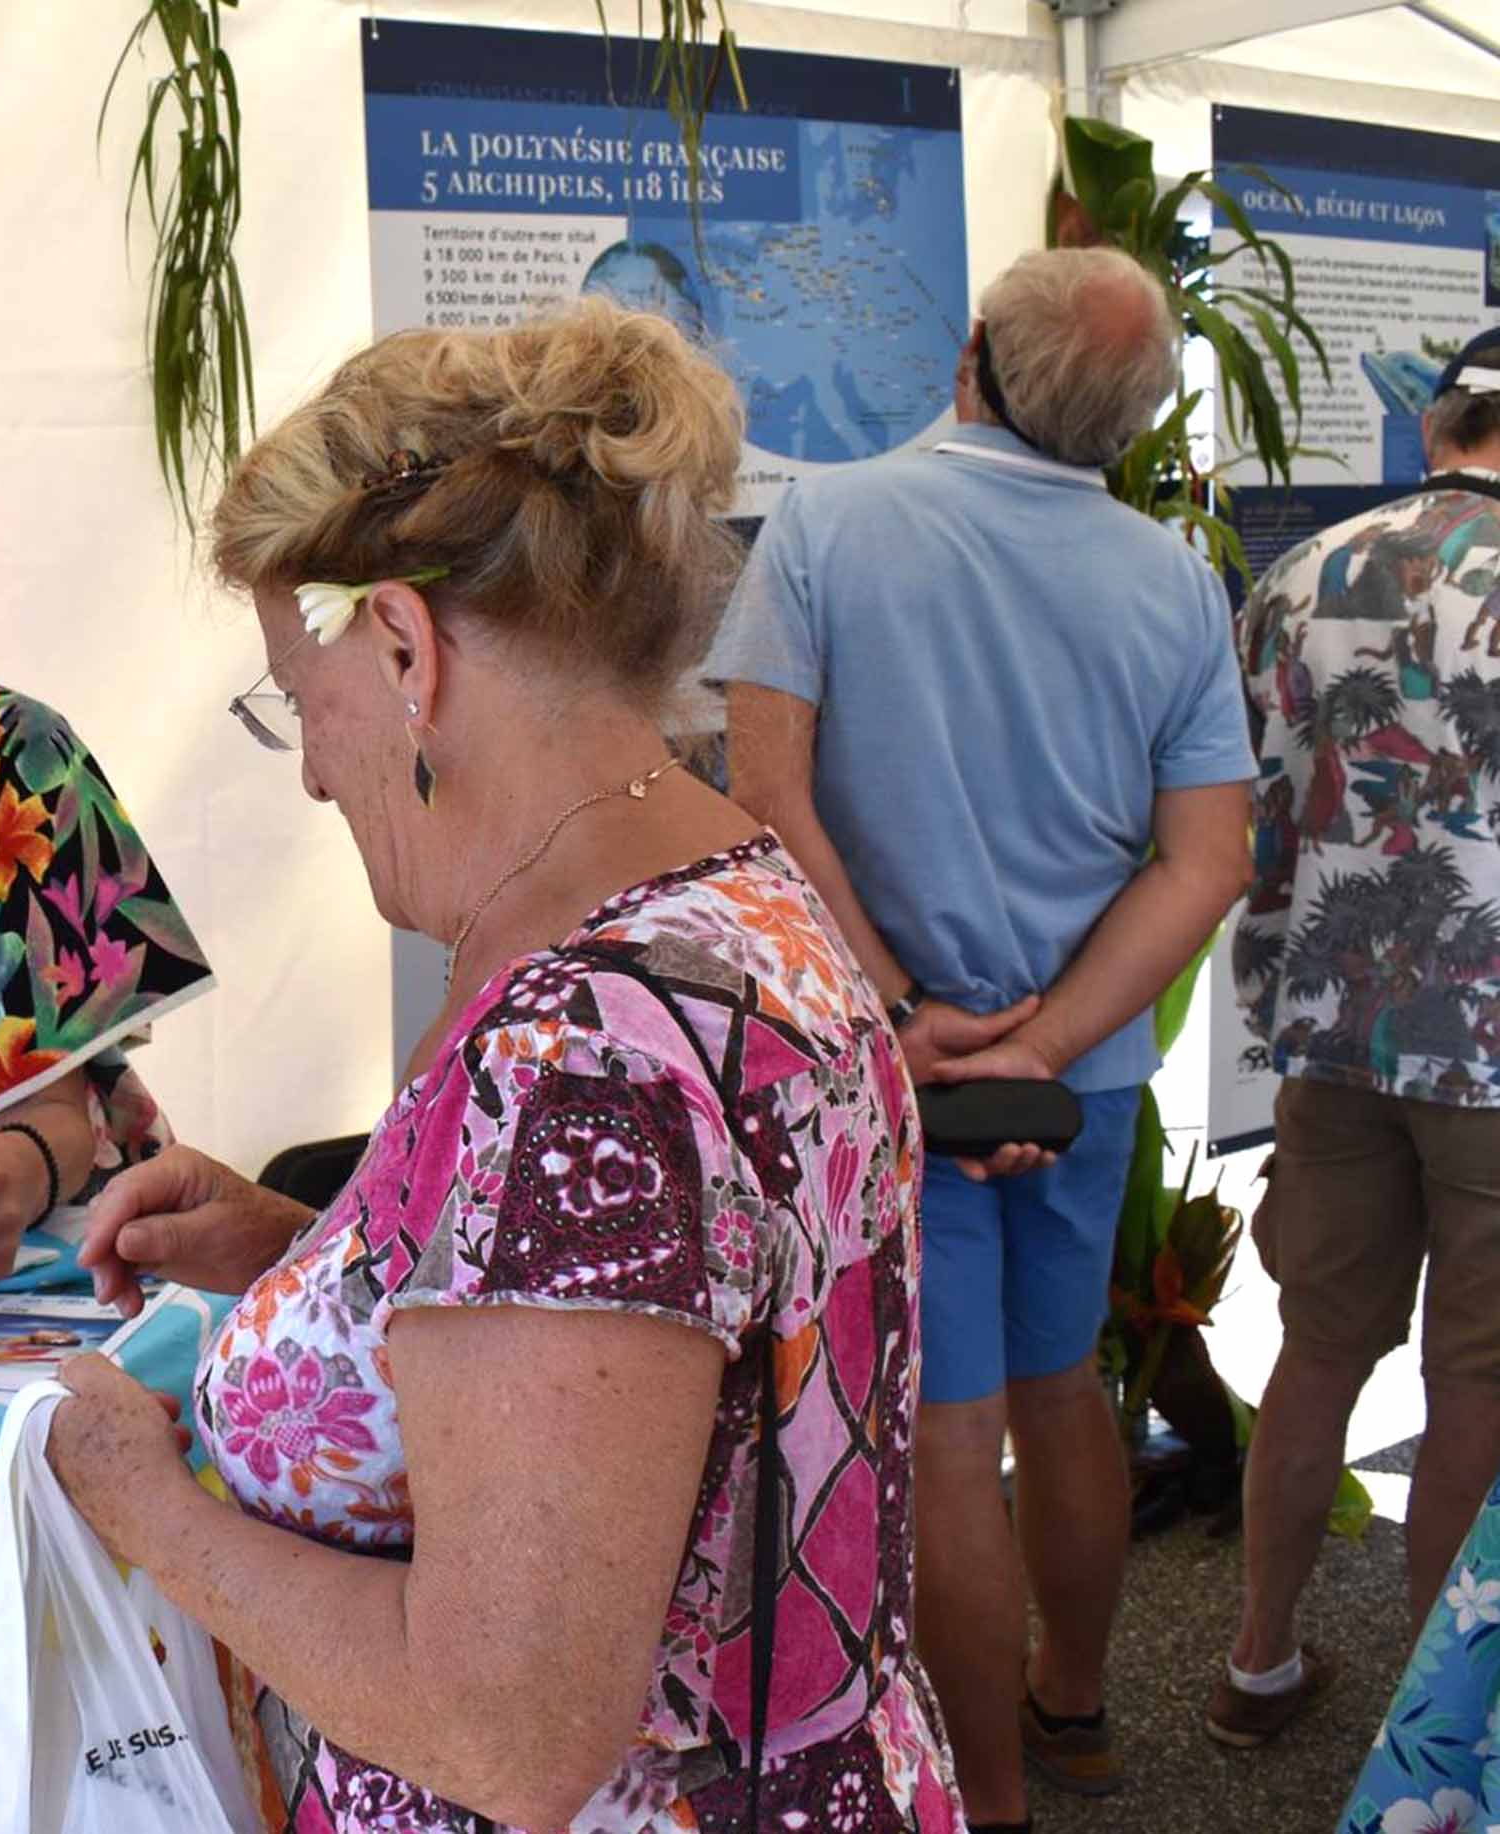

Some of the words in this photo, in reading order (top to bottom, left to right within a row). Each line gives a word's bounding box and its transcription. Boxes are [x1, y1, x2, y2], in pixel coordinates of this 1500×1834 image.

[421, 129, 459, 158] LA
[470, 124, 632, 166] POLYNÉSIE
[642, 141, 787, 177] FRANÇAISE
[421, 170, 438, 203] 5
[447, 170, 613, 205] ARCHIPELS,
[623, 170, 662, 201] 118
[1368, 201, 1390, 223] ET
[424, 226, 484, 240] Territoire
[489, 226, 563, 242] d'outre-mer
[437, 248, 453, 262] 18
[458, 248, 484, 263] 000
[488, 249, 510, 263] km
[513, 250, 528, 263] de
[473, 270, 495, 284] km
[501, 270, 518, 284] de
[460, 291, 479, 305] km
[481, 292, 496, 305] de
[470, 312, 490, 326] km
[494, 312, 511, 327] de
